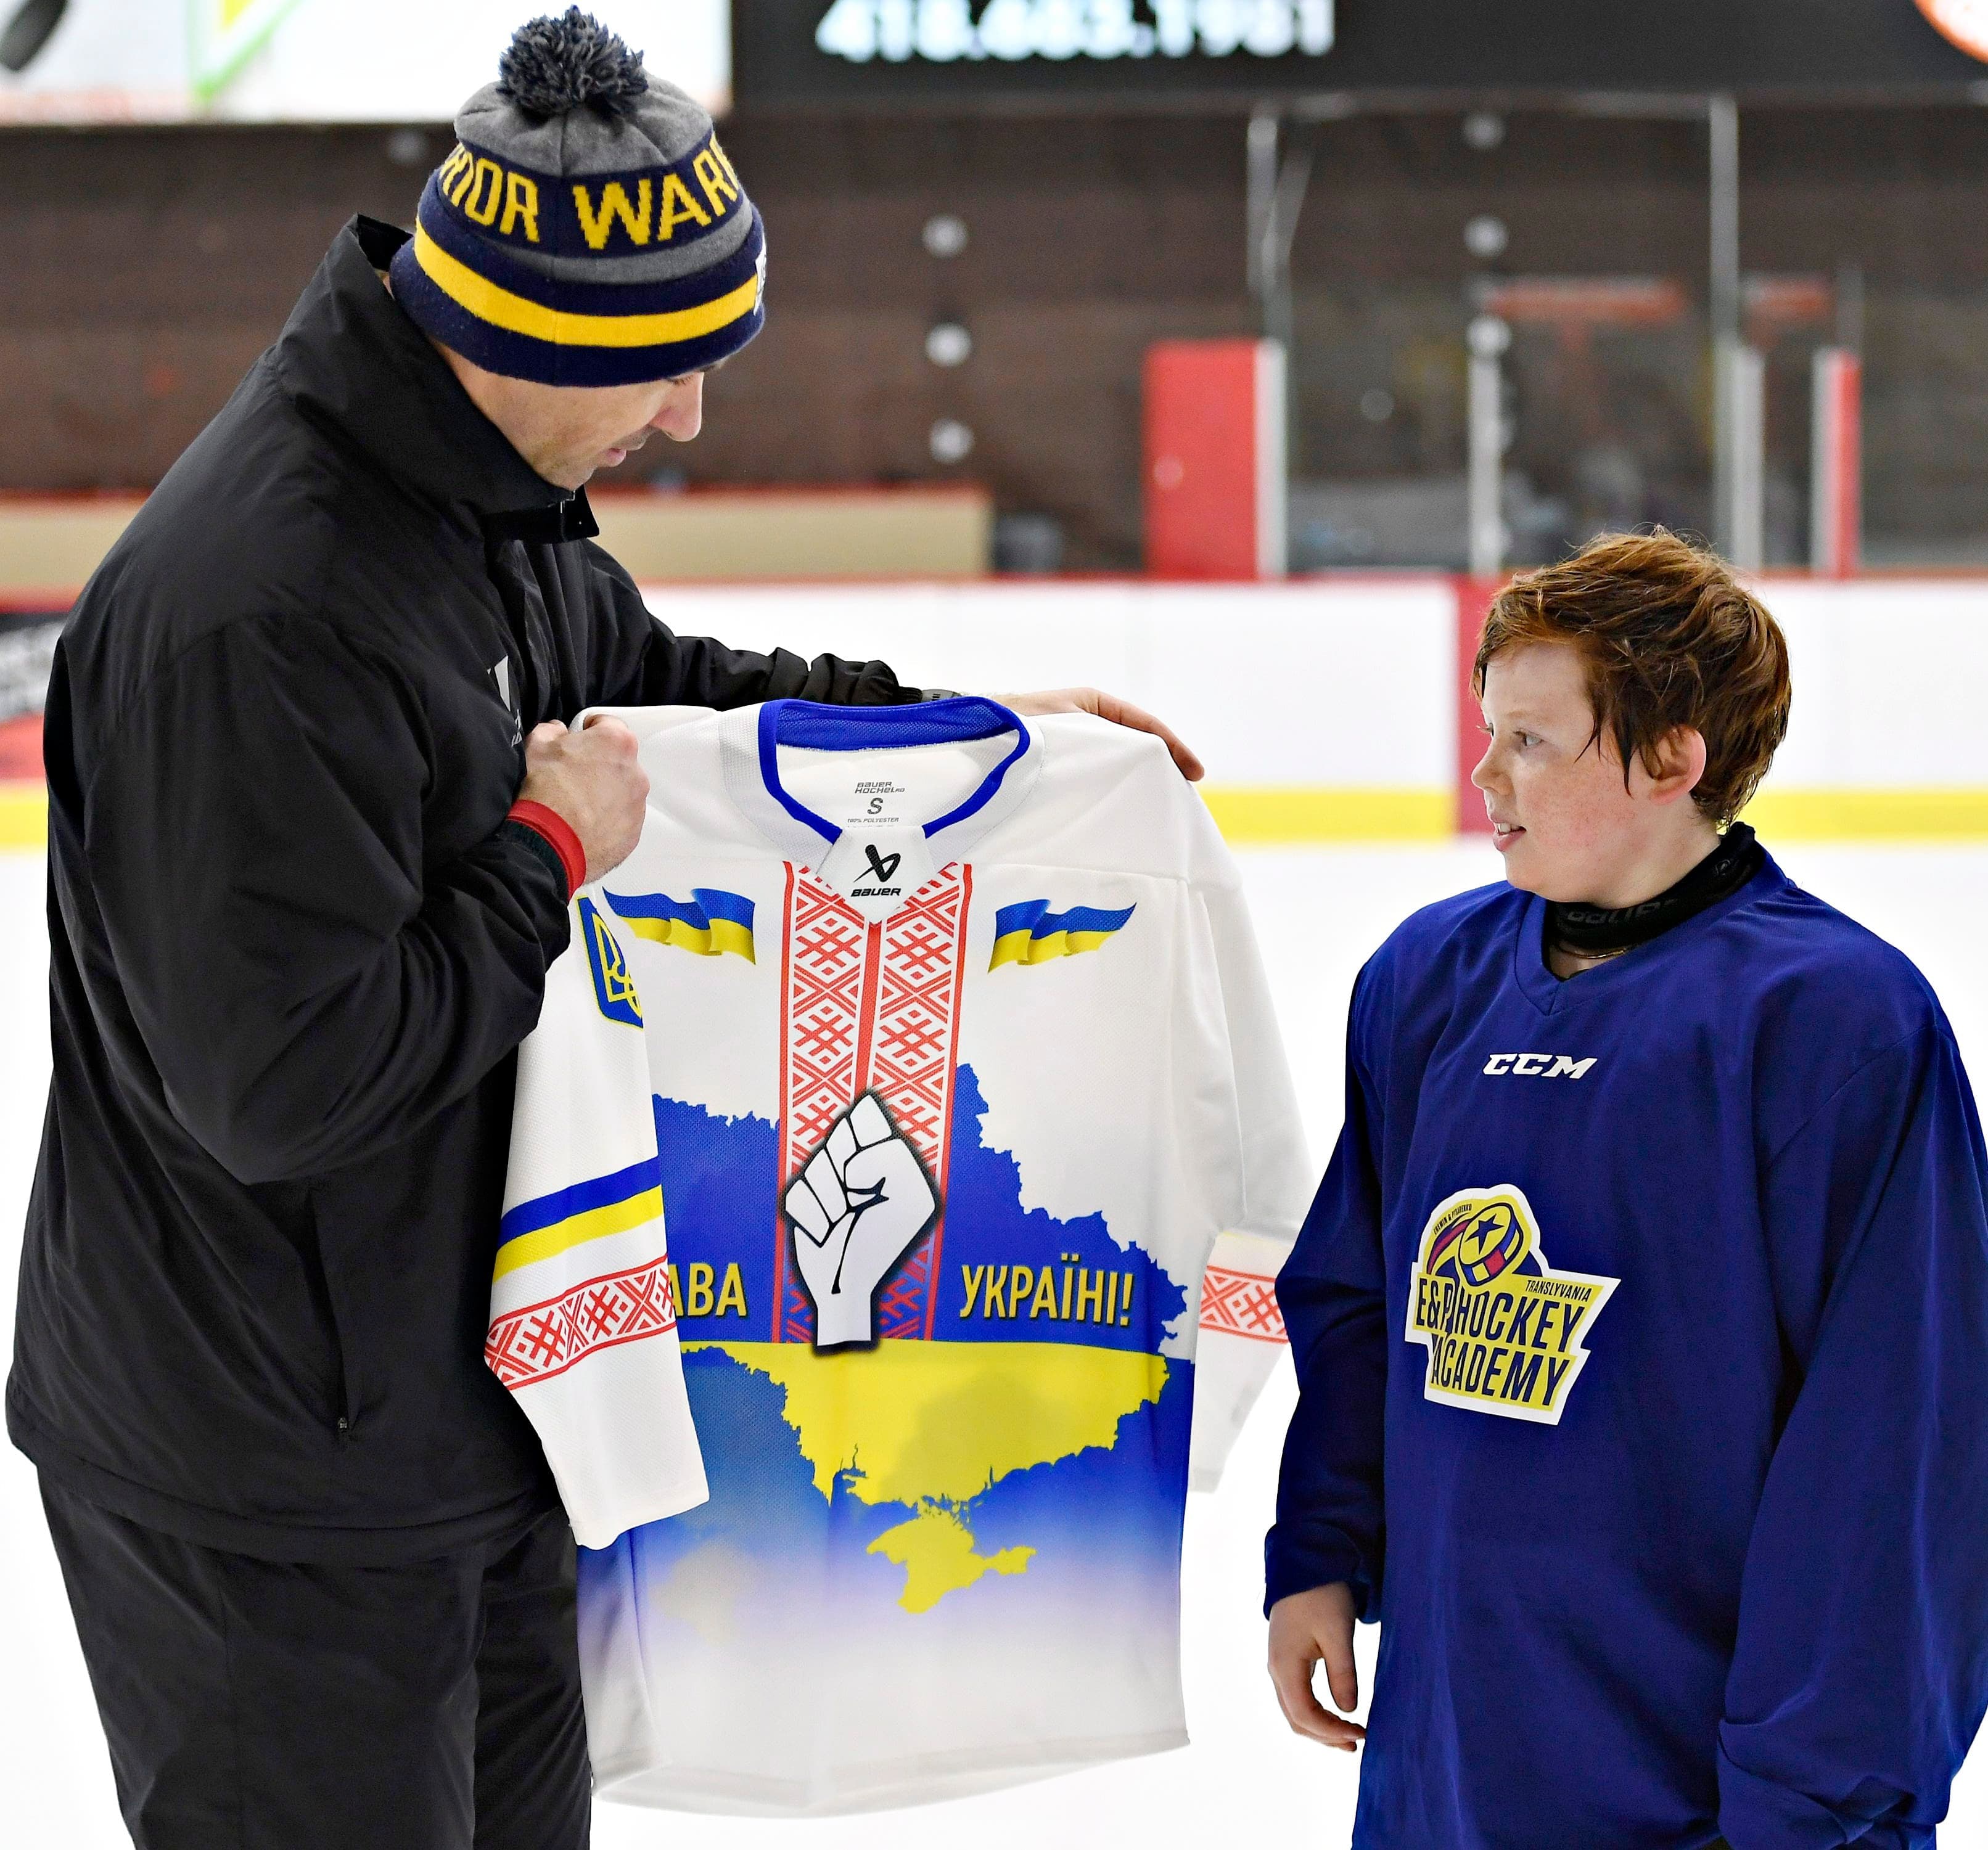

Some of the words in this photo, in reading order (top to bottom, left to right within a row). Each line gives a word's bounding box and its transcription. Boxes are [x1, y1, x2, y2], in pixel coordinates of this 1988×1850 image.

[867, 797, 884, 814] S
[850, 888, 902, 898] BAUER
[1482, 1053, 1598, 1079] CCM
[959, 1252, 1134, 1327] УКРАЇНІ!
[1525, 1279, 1593, 1303] TRANSLYVANIA
[1431, 1335, 1570, 1406] ACADEMY
